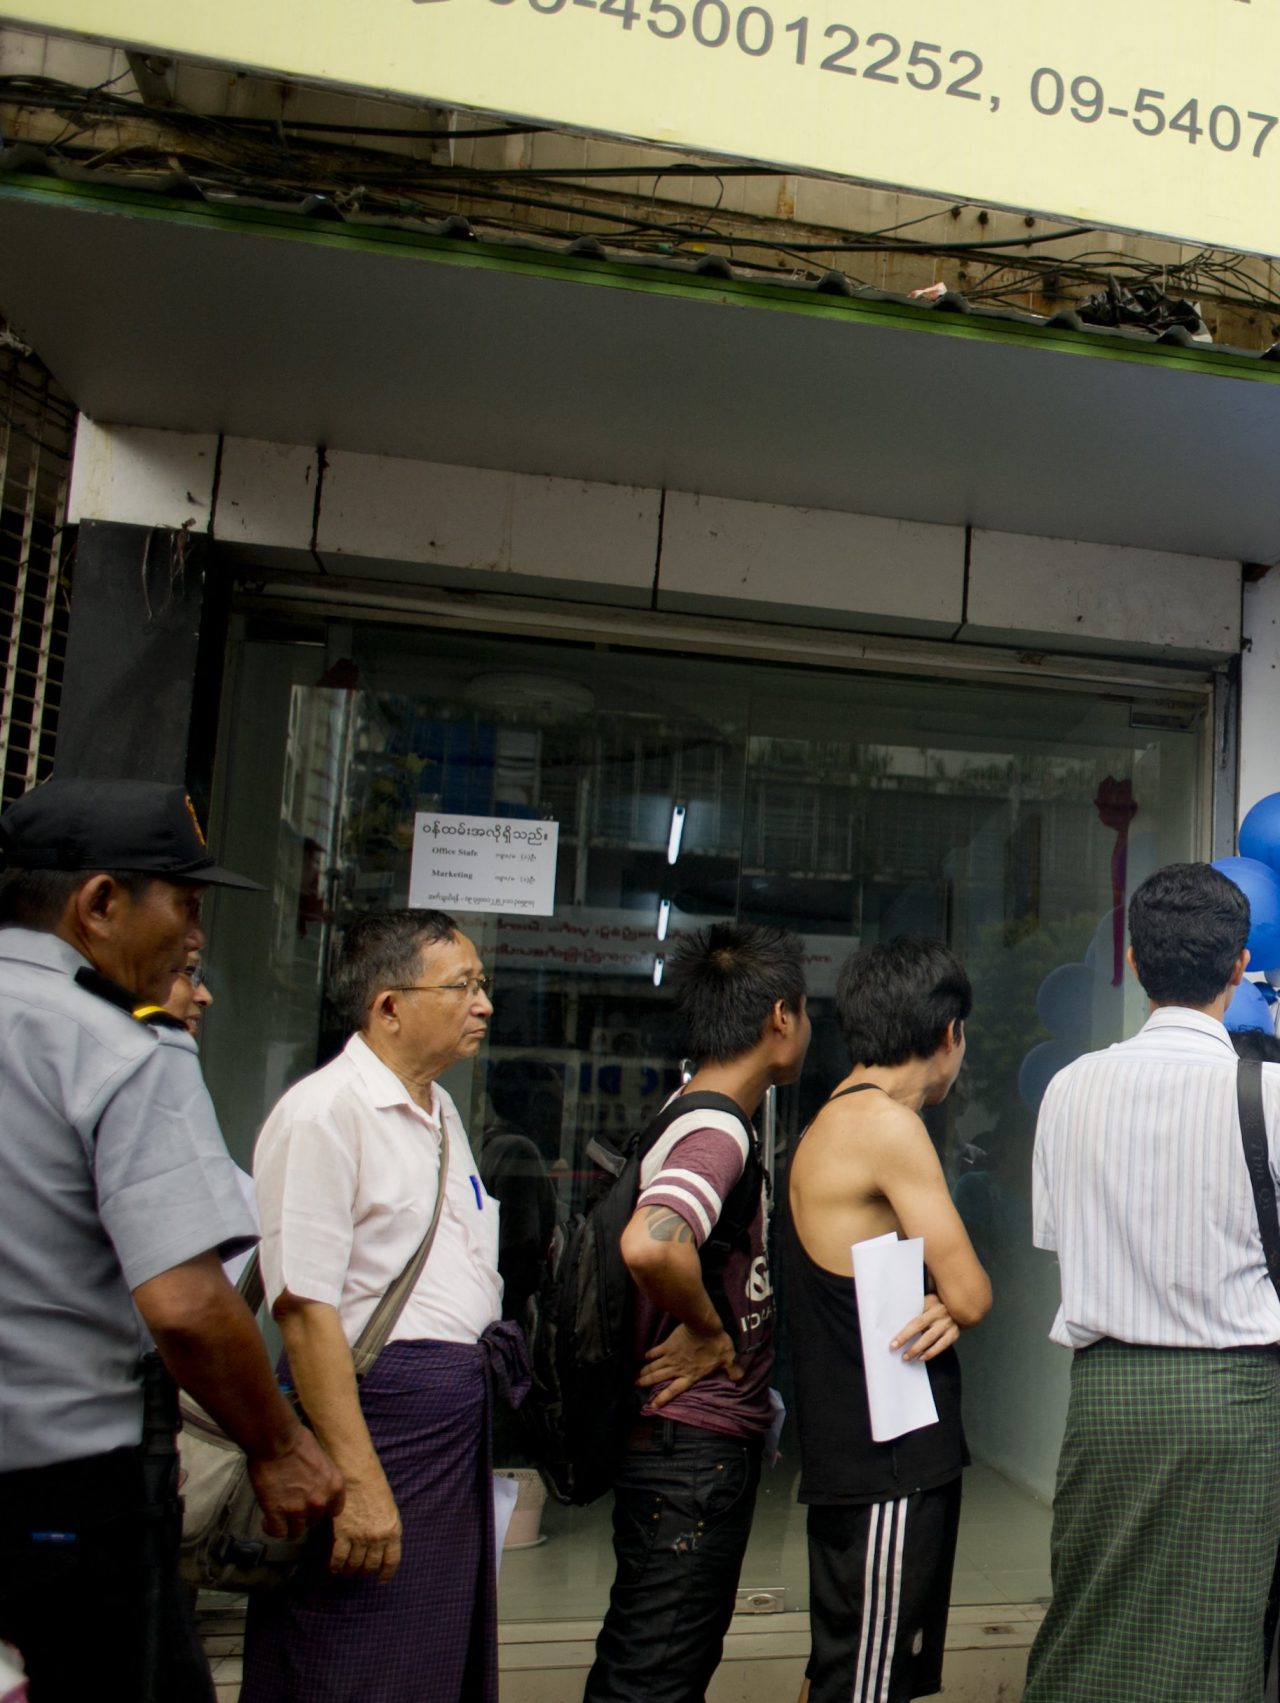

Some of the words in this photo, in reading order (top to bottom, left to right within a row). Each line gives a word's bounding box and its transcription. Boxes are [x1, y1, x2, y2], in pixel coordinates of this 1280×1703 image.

[486, 0, 1001, 113] -450012252,
[431, 846, 456, 856] Office
[431, 869, 473, 880] Marketing
